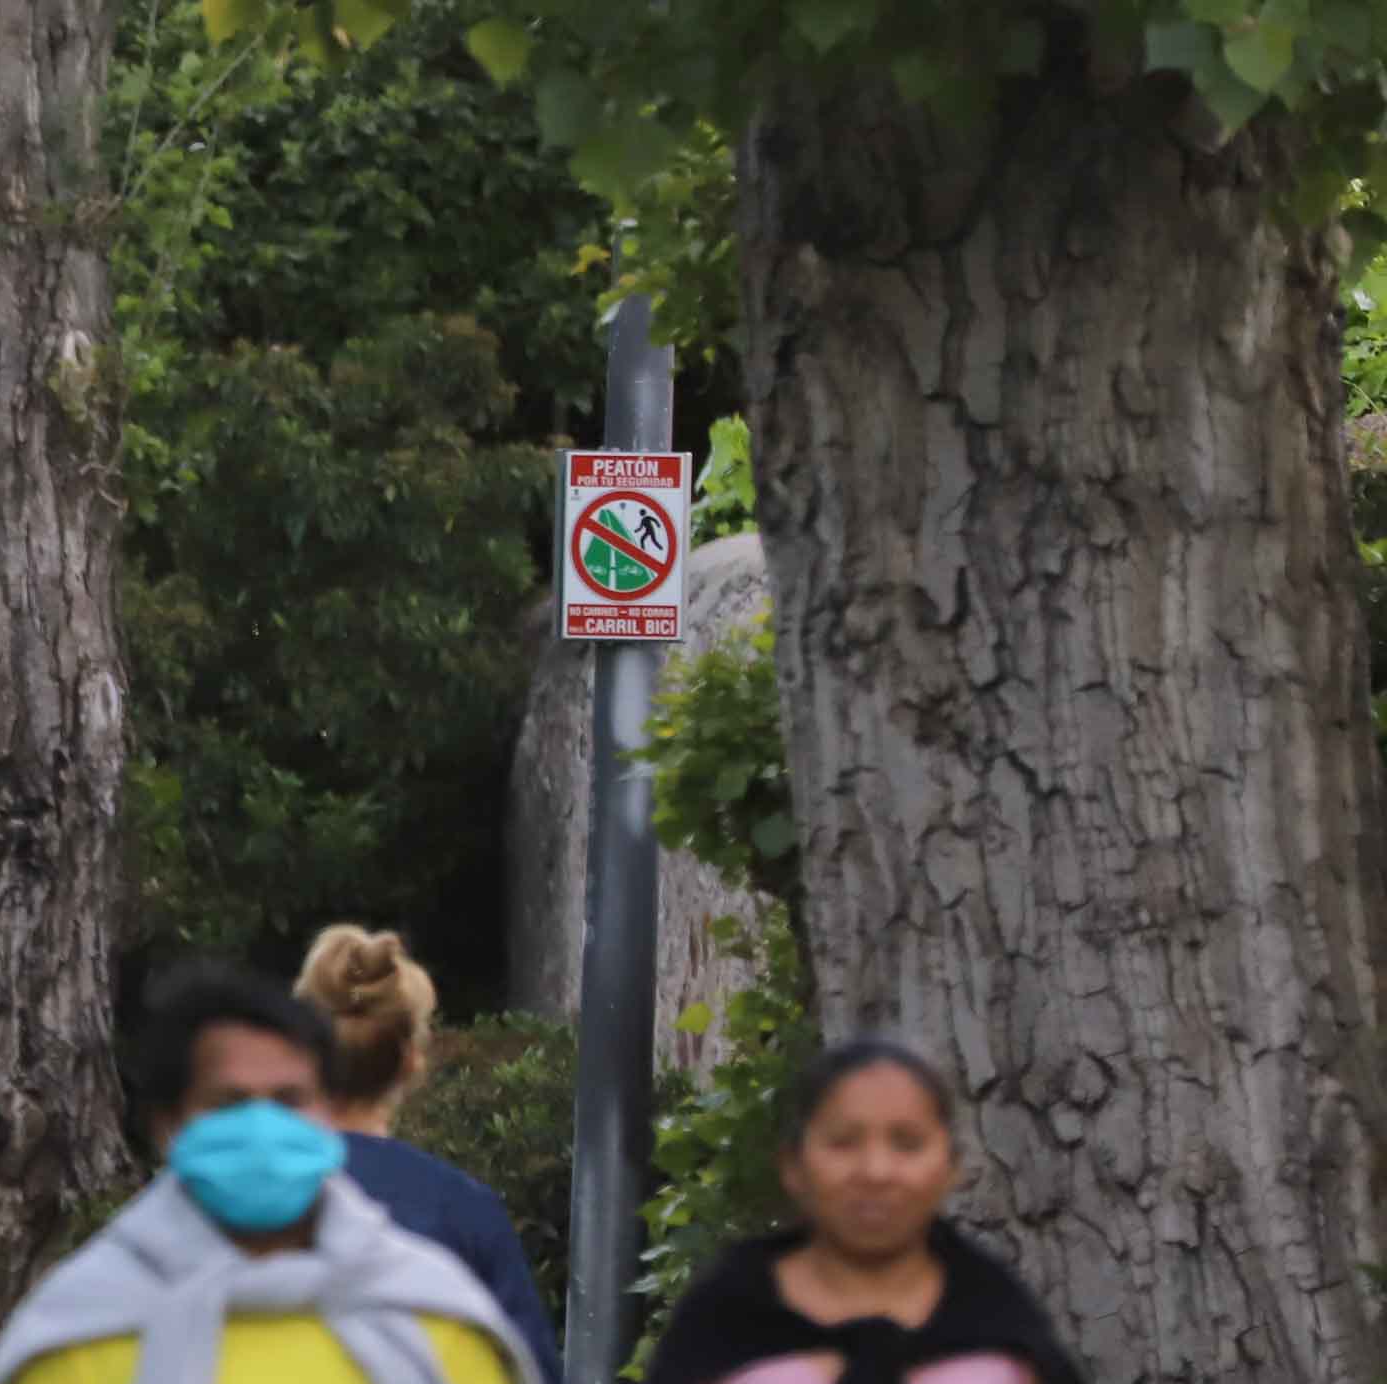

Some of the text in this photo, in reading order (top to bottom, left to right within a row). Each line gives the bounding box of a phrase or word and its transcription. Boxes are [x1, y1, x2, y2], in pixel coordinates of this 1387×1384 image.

[593, 457, 659, 477] PEATÓN
[577, 475, 674, 488] POR TU SEGURIDAD
[585, 618, 641, 634] CARRIL
[645, 619, 675, 635] BICI
